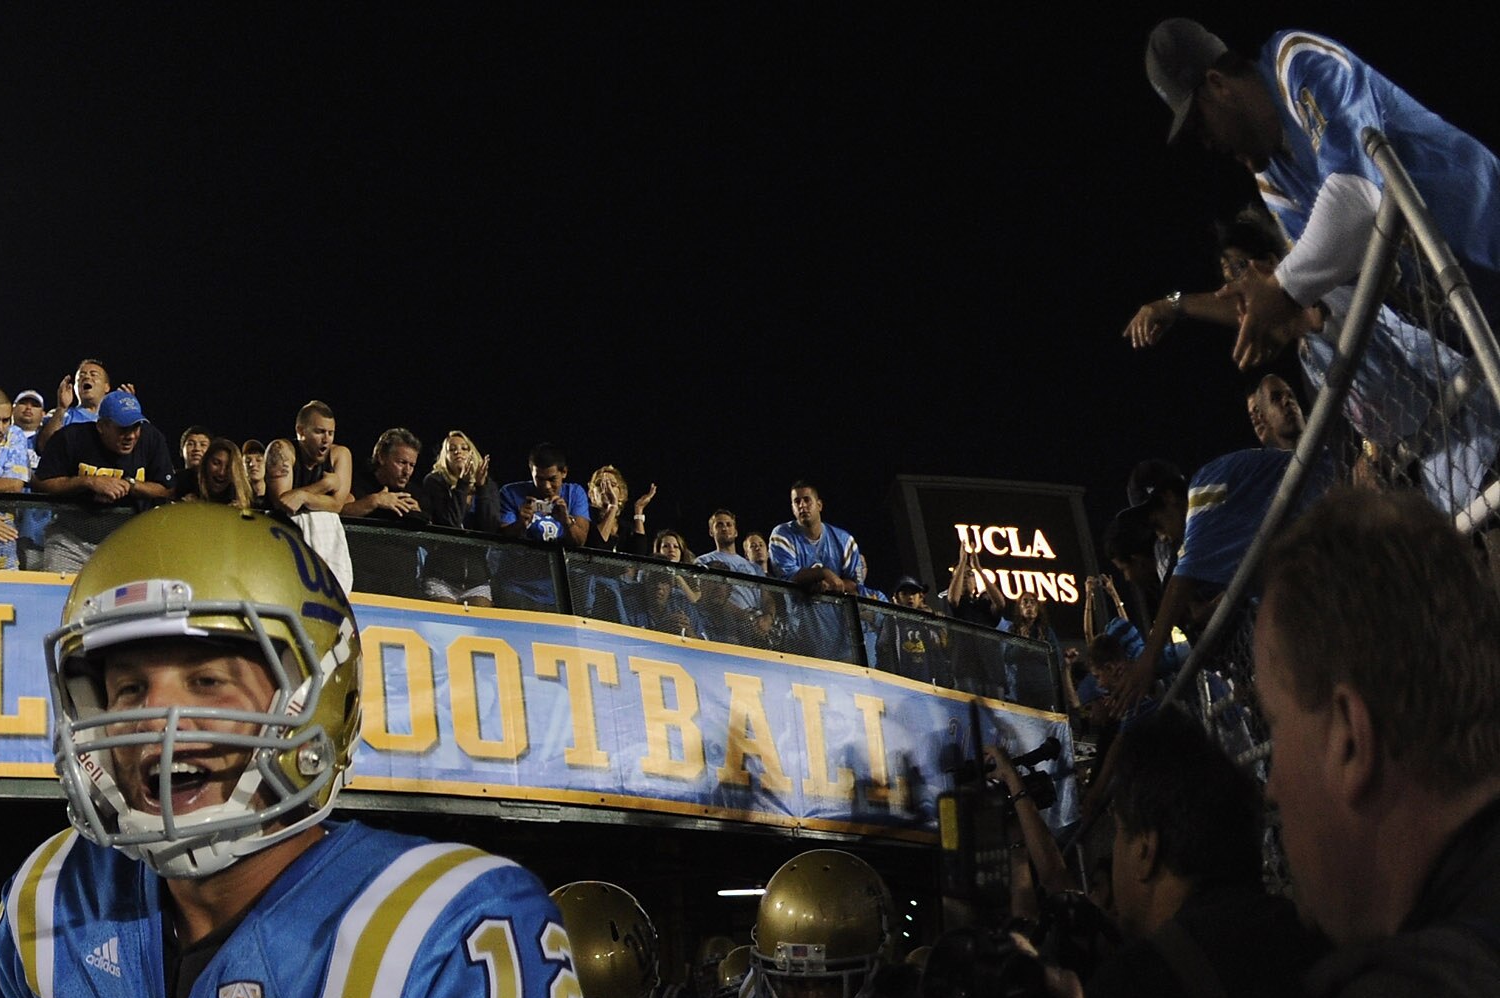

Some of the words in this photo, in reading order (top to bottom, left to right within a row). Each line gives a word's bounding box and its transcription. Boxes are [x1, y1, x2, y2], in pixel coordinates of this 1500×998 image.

[954, 523, 1056, 559] UCLA
[952, 567, 1080, 604] RUINS
[359, 625, 911, 812] OOTBALL
[85, 953, 122, 978] adidas
